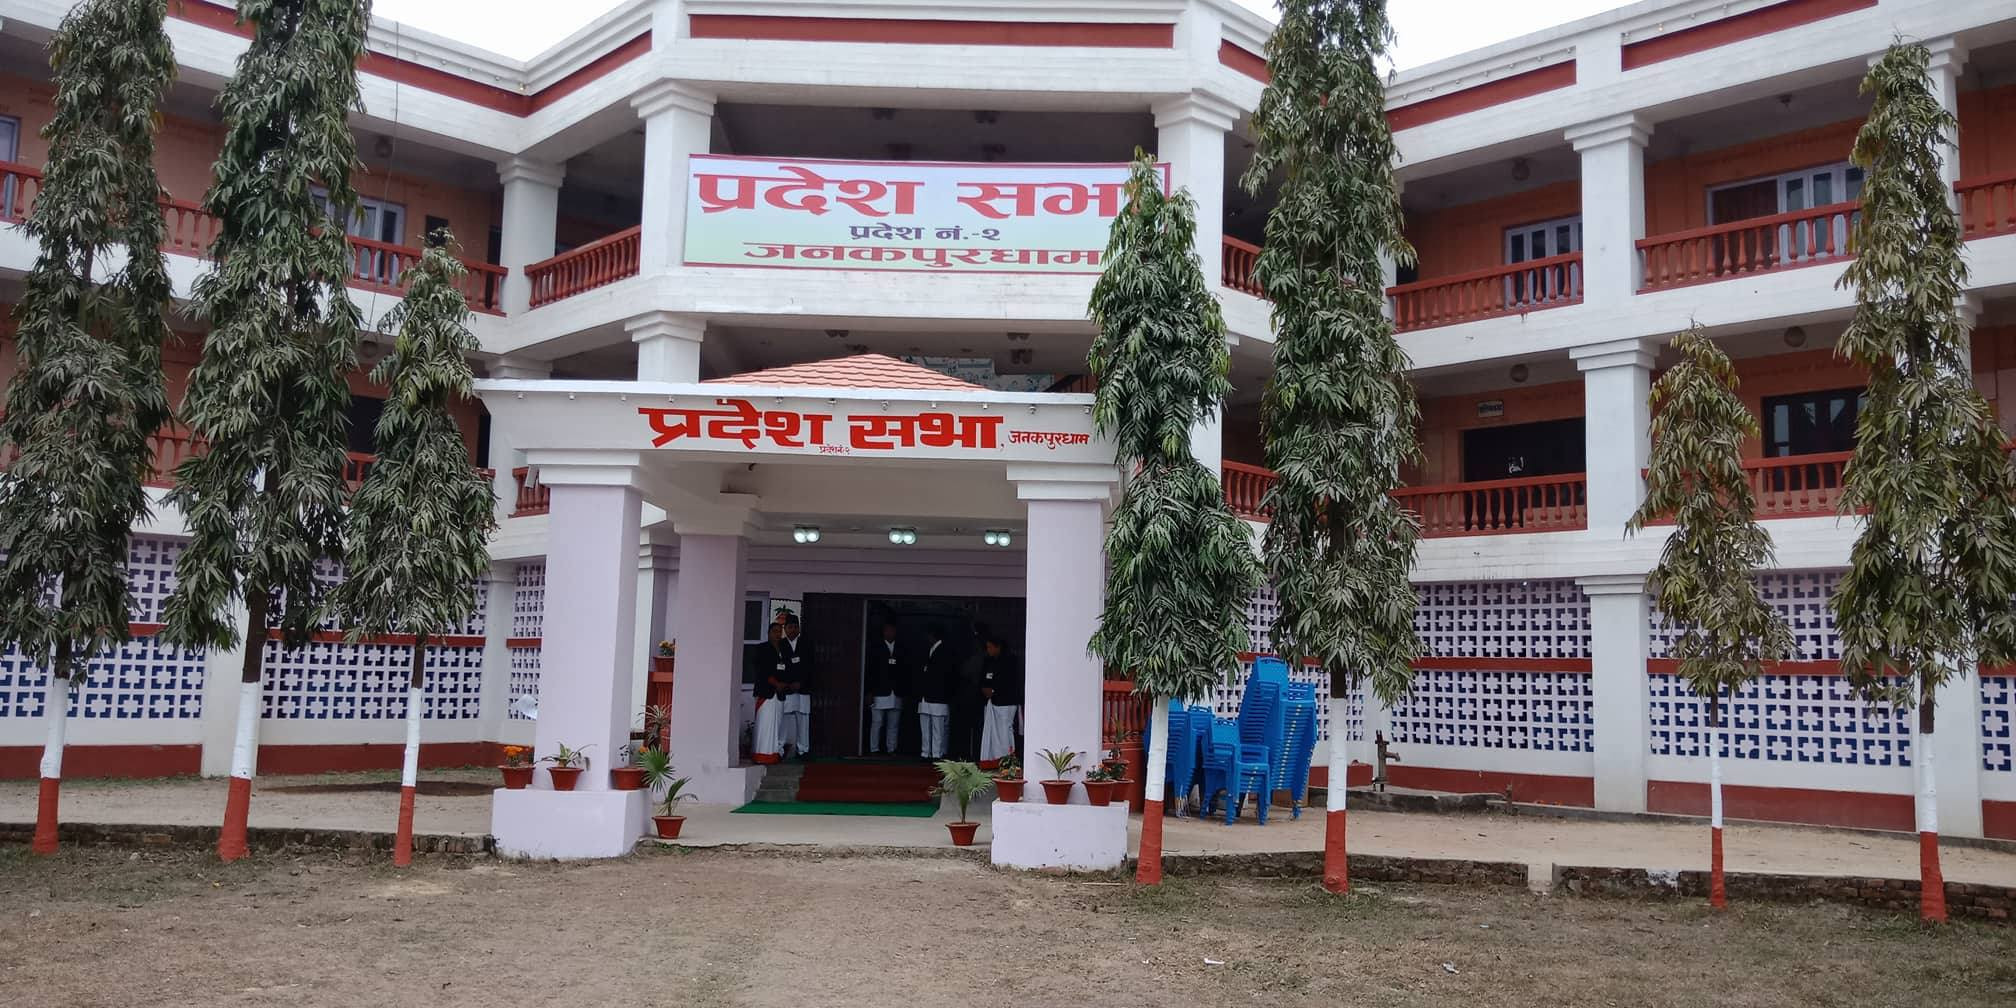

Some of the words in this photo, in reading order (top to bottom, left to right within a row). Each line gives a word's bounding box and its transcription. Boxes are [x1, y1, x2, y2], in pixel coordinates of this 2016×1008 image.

[693, 166, 925, 217] प्रदेश
[849, 222, 925, 240] प्रदेश
[743, 242, 1103, 267] जनकपुरधाम
[638, 398, 832, 449] प्रदेश
[1008, 430, 1090, 450] जनकपुरधाम
